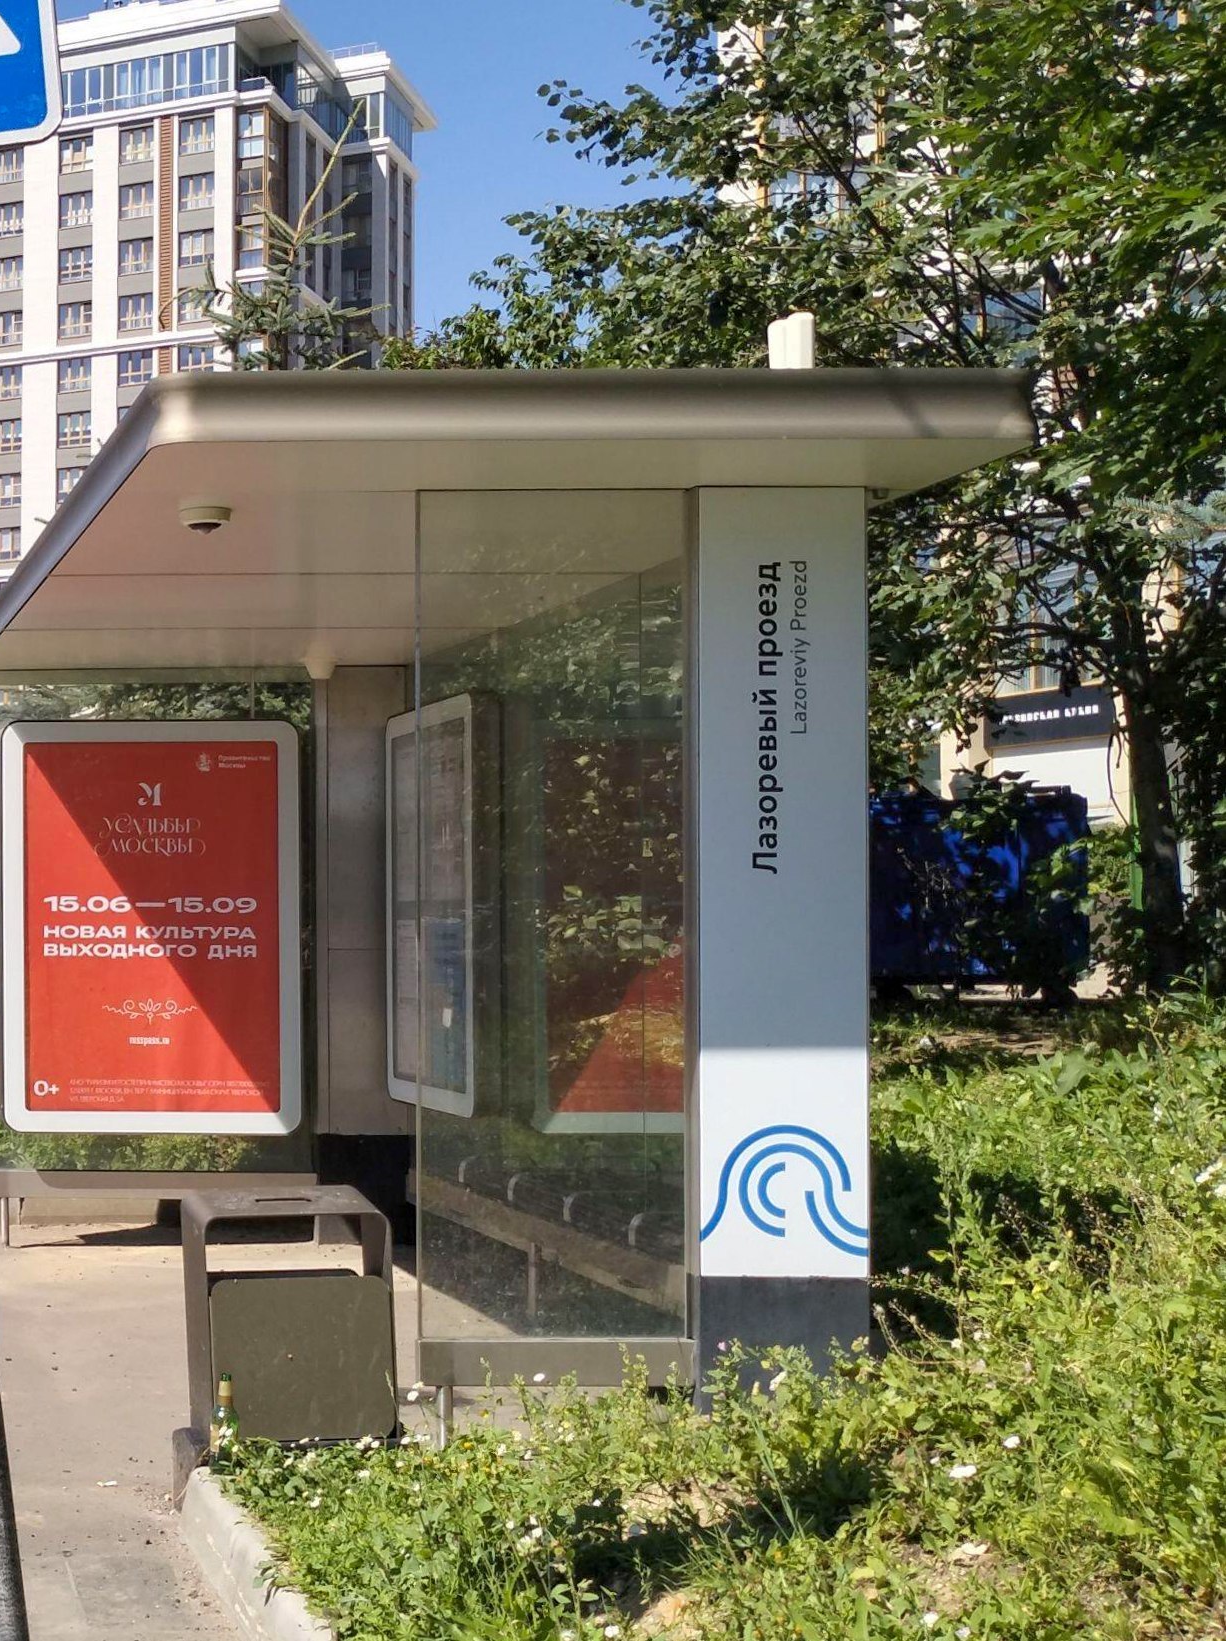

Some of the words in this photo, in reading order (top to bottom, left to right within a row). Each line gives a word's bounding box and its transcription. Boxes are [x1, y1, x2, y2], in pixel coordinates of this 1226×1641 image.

[790, 560, 807, 631] Proezd
[758, 561, 783, 676] проезд
[790, 638, 810, 734] Lazoreviy
[752, 689, 783, 874] Лазоревый
[94, 837, 206, 857] МОСКВЫ
[43, 925, 127, 941] НОВАЯ
[136, 925, 256, 940] КУЛЬТУРА
[43, 943, 198, 959] ВЫХОДНОГО
[208, 944, 257, 960] ДНЯ
[33, 1080, 60, 1096] 0+
